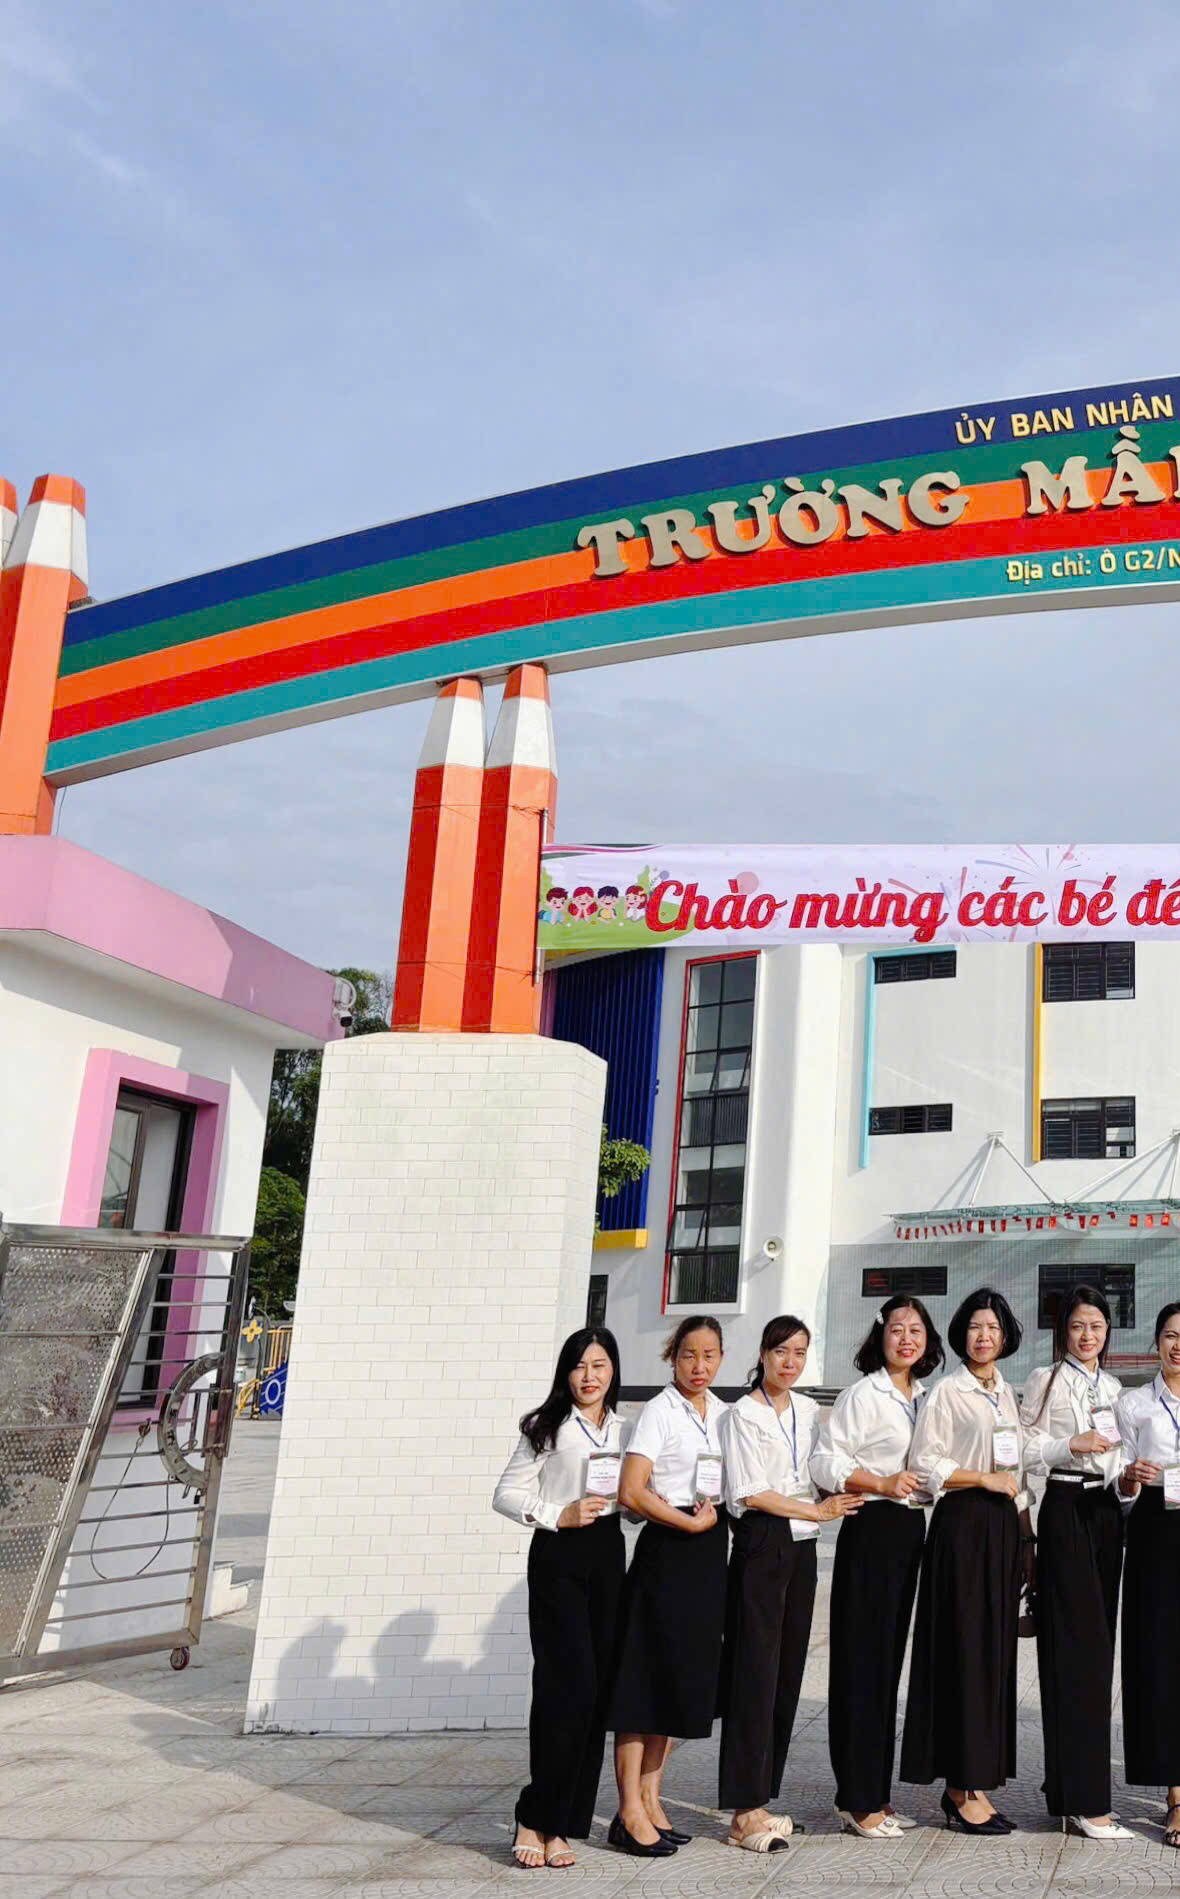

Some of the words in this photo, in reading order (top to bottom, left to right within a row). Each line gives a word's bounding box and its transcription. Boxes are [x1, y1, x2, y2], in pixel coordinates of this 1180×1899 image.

[955, 411, 995, 444] ỦY
[1011, 407, 1075, 437] BAN
[1086, 392, 1174, 427] NHÂN
[577, 471, 971, 576] TRƯỜNG
[1006, 560, 1043, 585] Địa
[1051, 553, 1092, 577] chỉ:
[1100, 548, 1117, 573] Ô
[645, 878, 787, 931] Chào
[789, 877, 949, 942] mừng
[957, 875, 1048, 928] các
[1057, 872, 1116, 928] bé
